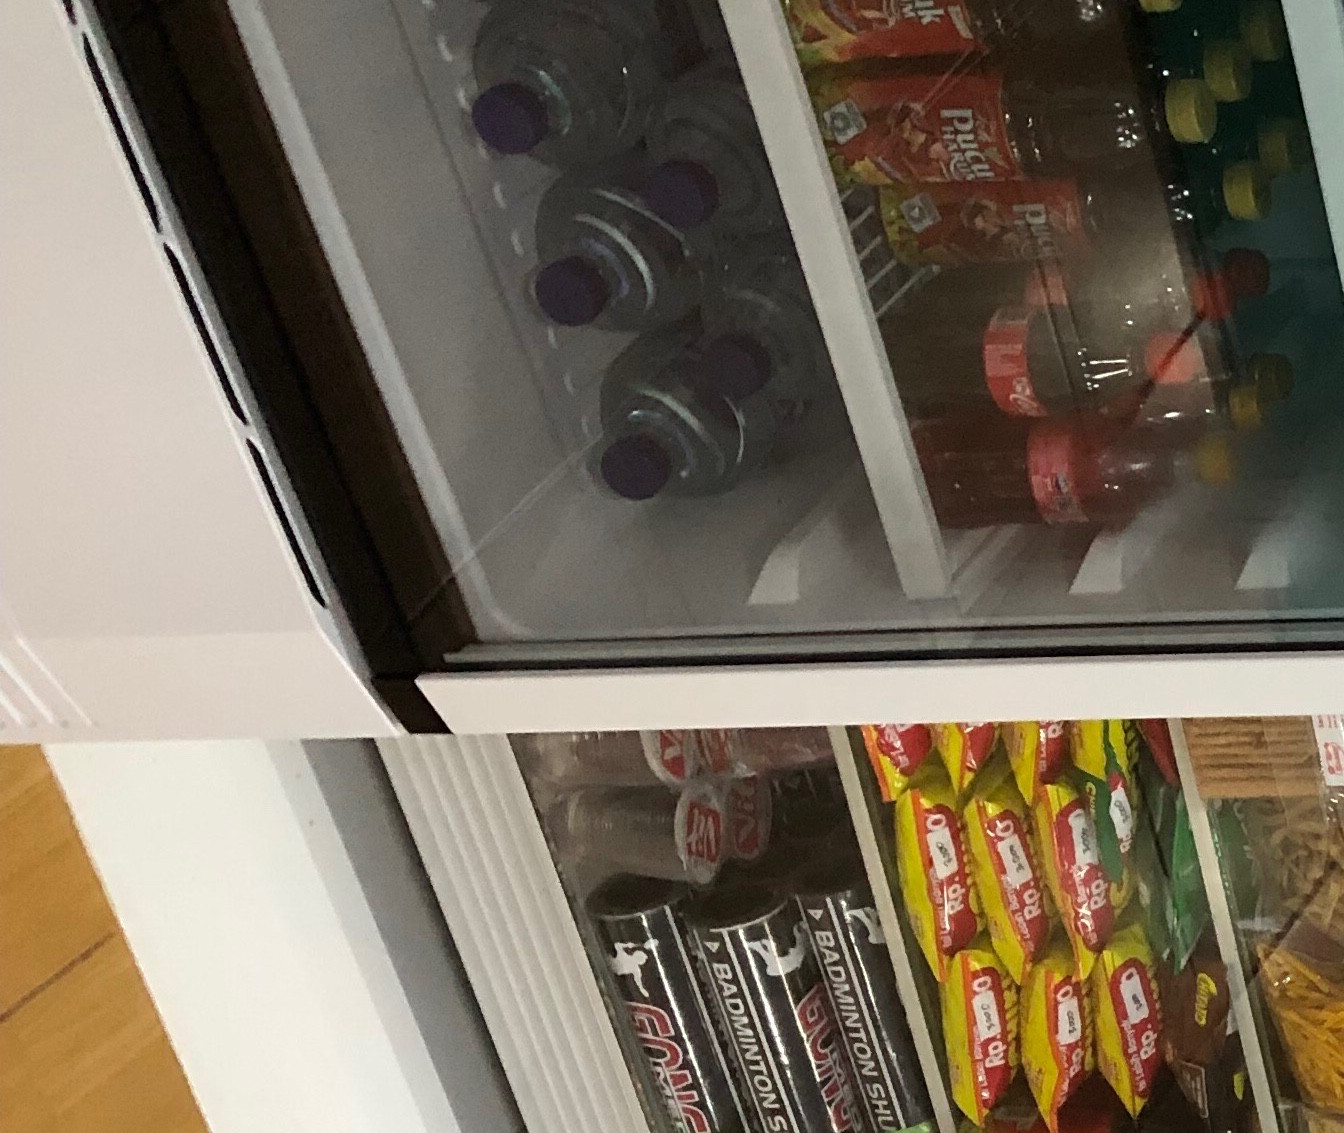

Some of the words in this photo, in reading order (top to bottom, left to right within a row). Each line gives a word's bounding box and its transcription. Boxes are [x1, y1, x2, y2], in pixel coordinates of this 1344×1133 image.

[945, 875, 965, 914] Rp.
[1022, 880, 1042, 919] Rp.
[813, 930, 883, 1080] BADMINTON
[710, 963, 778, 1109] BADMINTON
[987, 1034, 1006, 1068] Rp.
